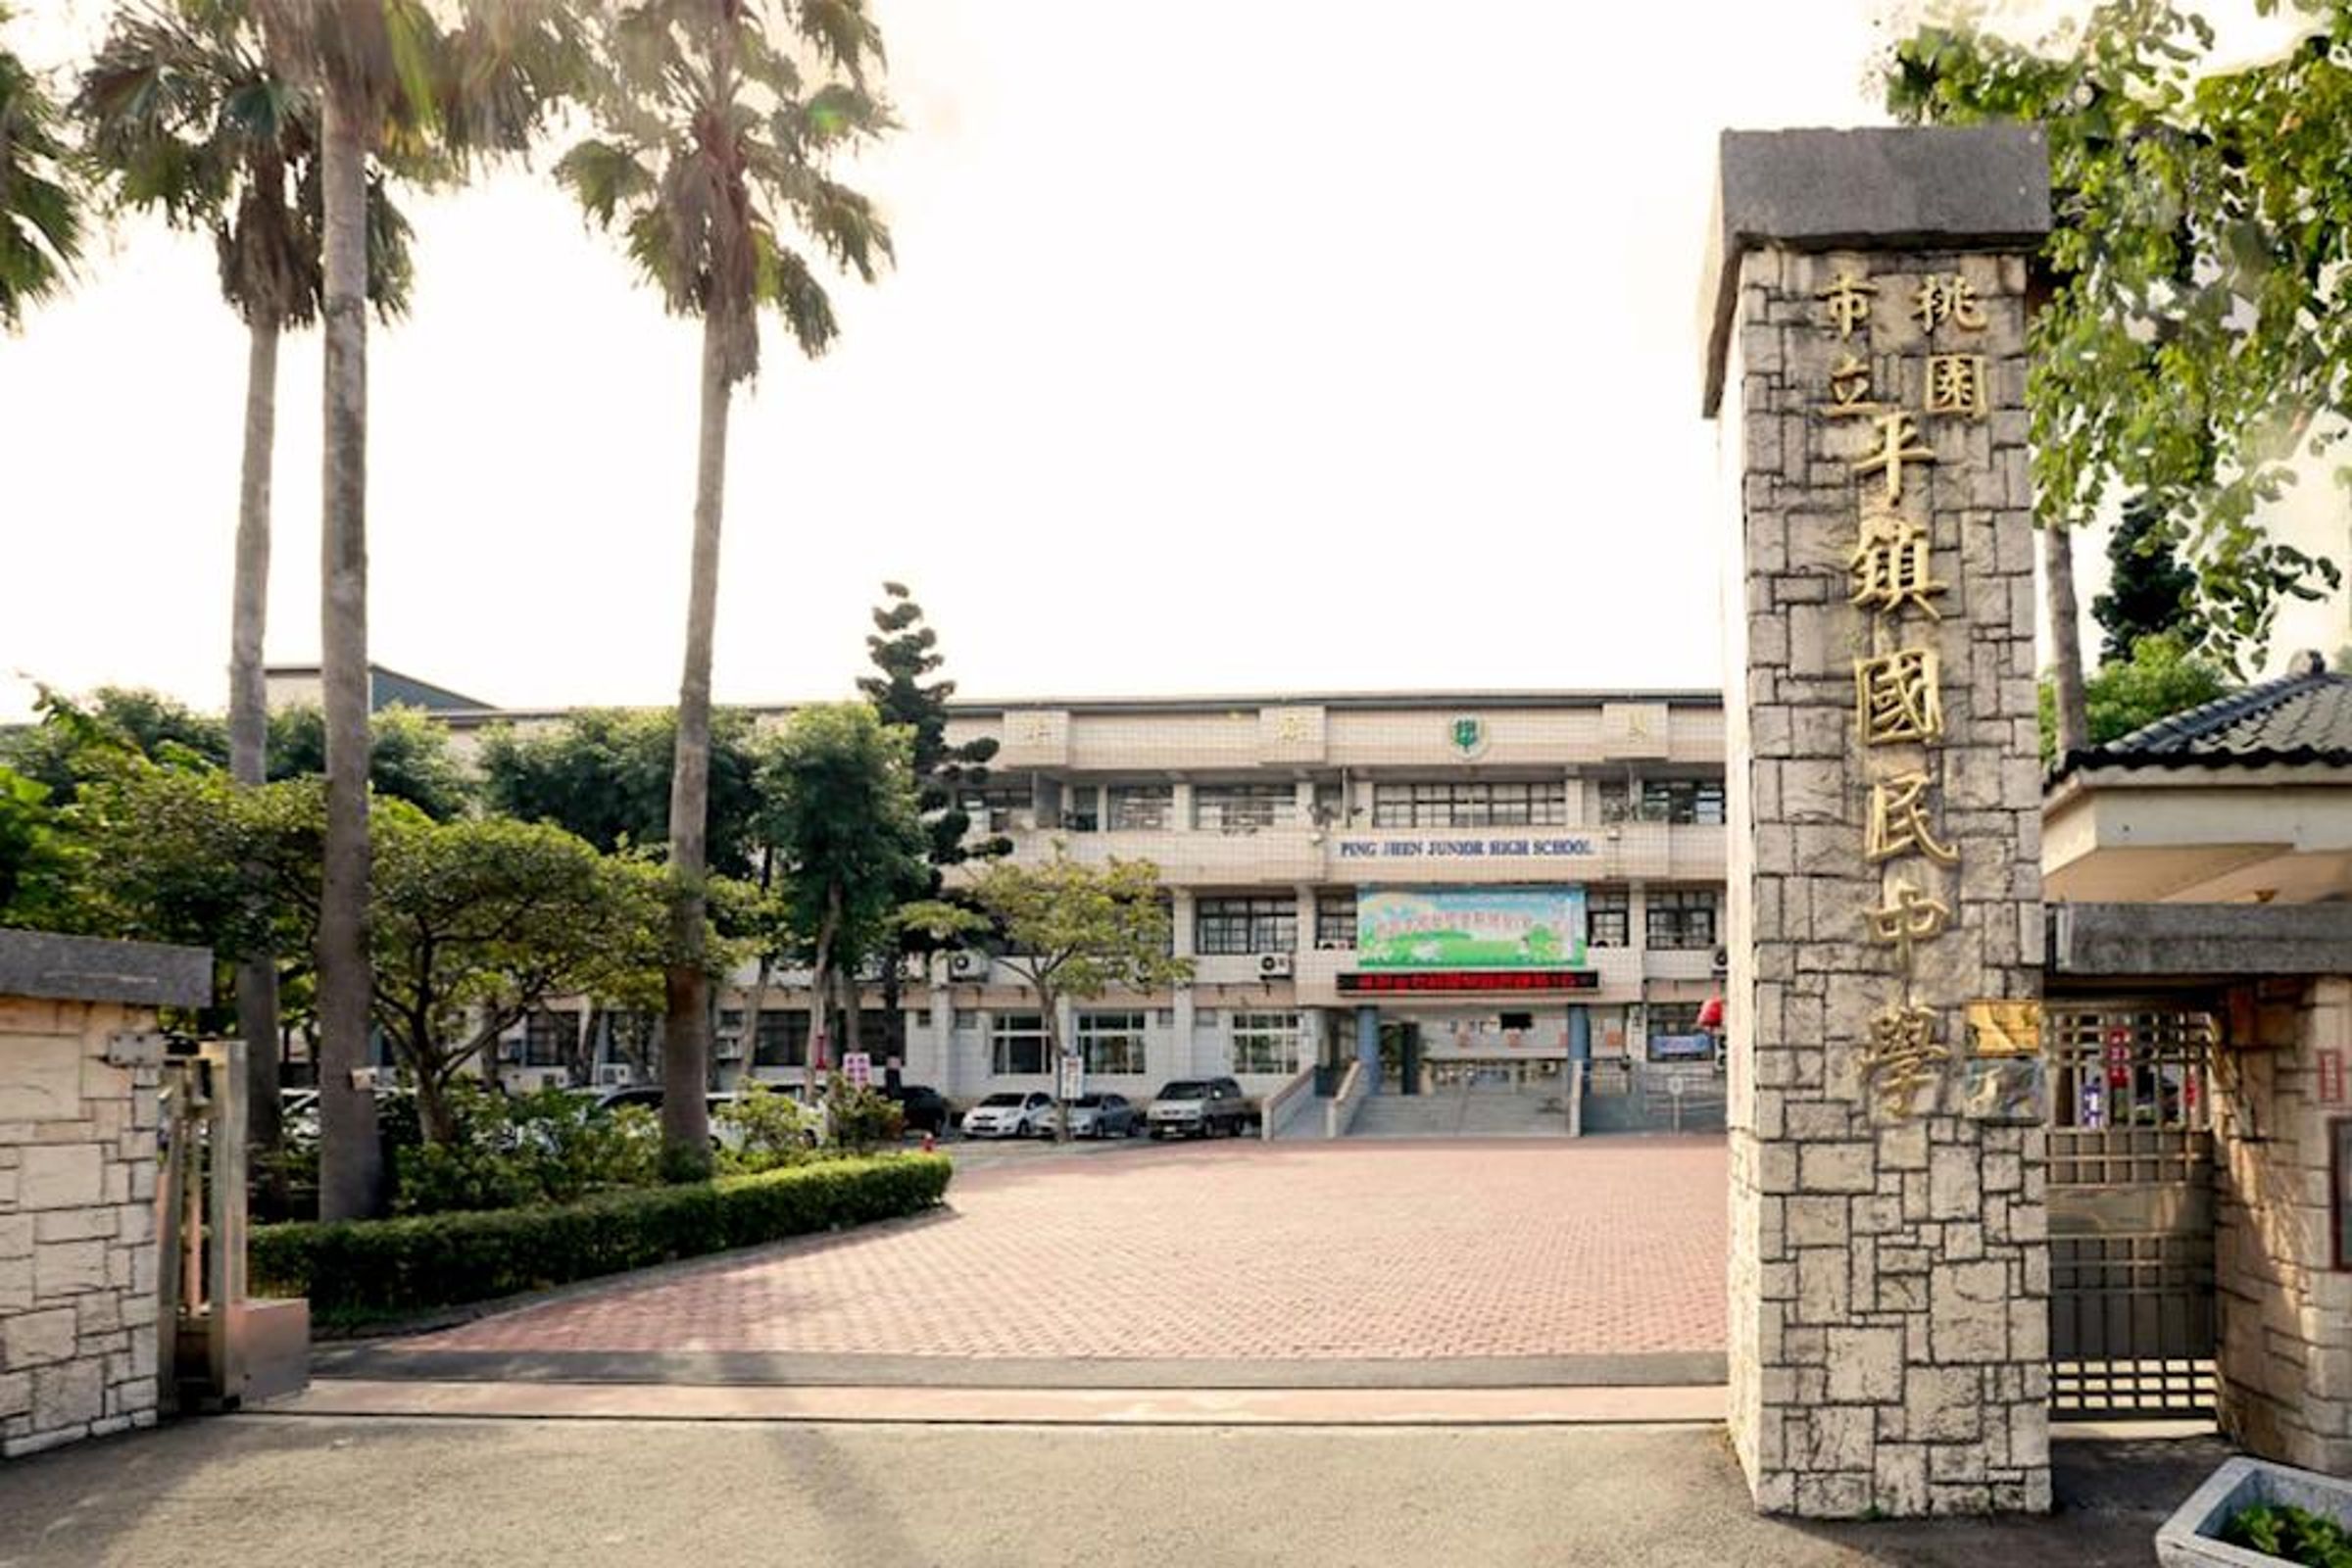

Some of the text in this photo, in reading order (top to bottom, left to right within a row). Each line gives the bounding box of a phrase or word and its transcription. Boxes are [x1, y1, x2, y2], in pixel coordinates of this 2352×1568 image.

[1820, 273, 1879, 416] 市立
[1849, 412, 1960, 1118] 平鎮國民中學
[1342, 841, 1377, 858] PING
[1428, 840, 1484, 857] JUNIOR
[1490, 840, 1529, 856] HIGH
[1533, 839, 1594, 856] SCHOOL
